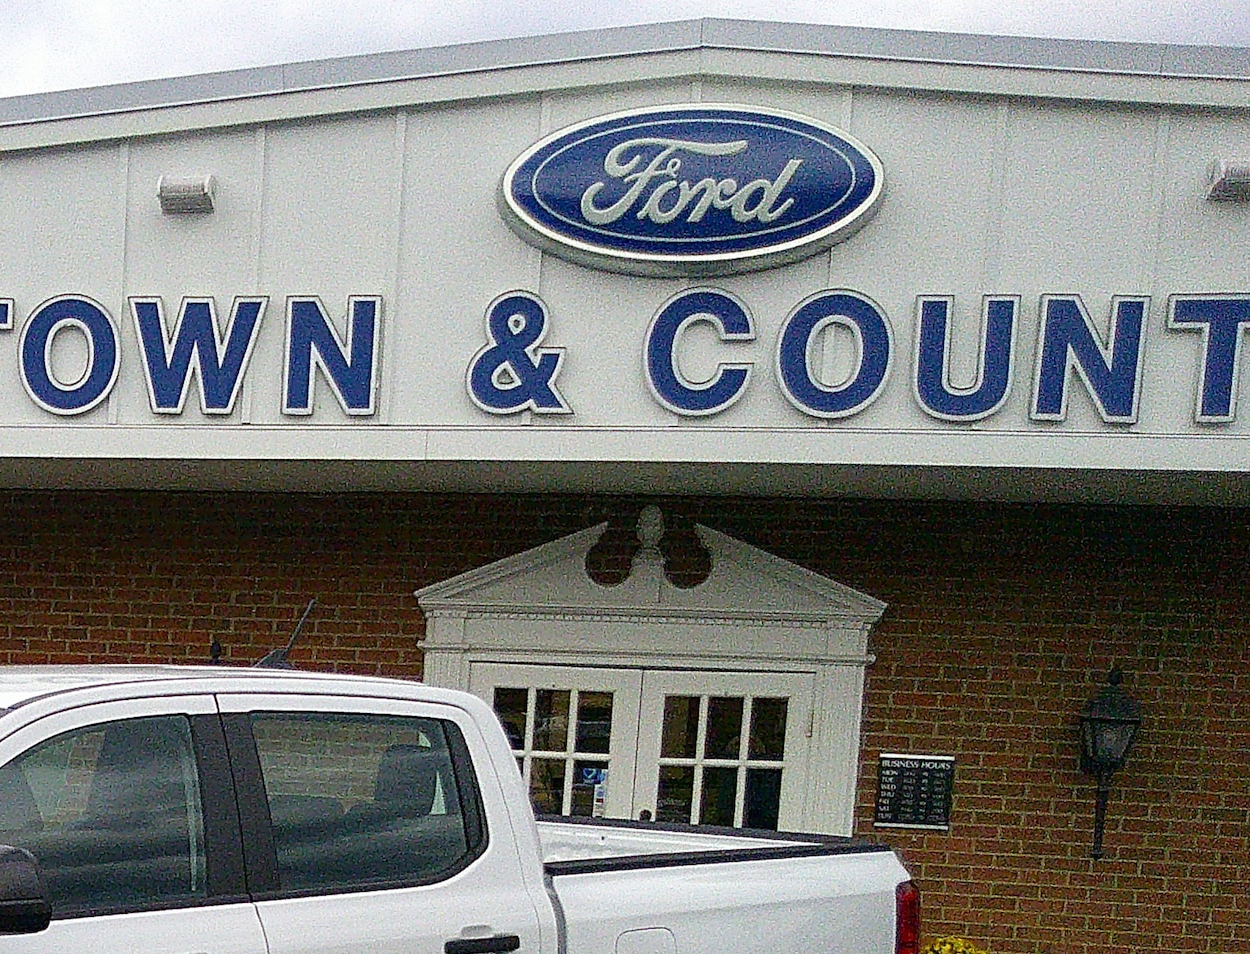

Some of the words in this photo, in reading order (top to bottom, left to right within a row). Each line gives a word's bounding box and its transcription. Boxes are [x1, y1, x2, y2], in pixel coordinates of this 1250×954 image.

[581, 137, 804, 226] Ford
[466, 289, 574, 415] &
[881, 760, 920, 768] BUSINESS
[920, 761, 951, 770] HOURS
